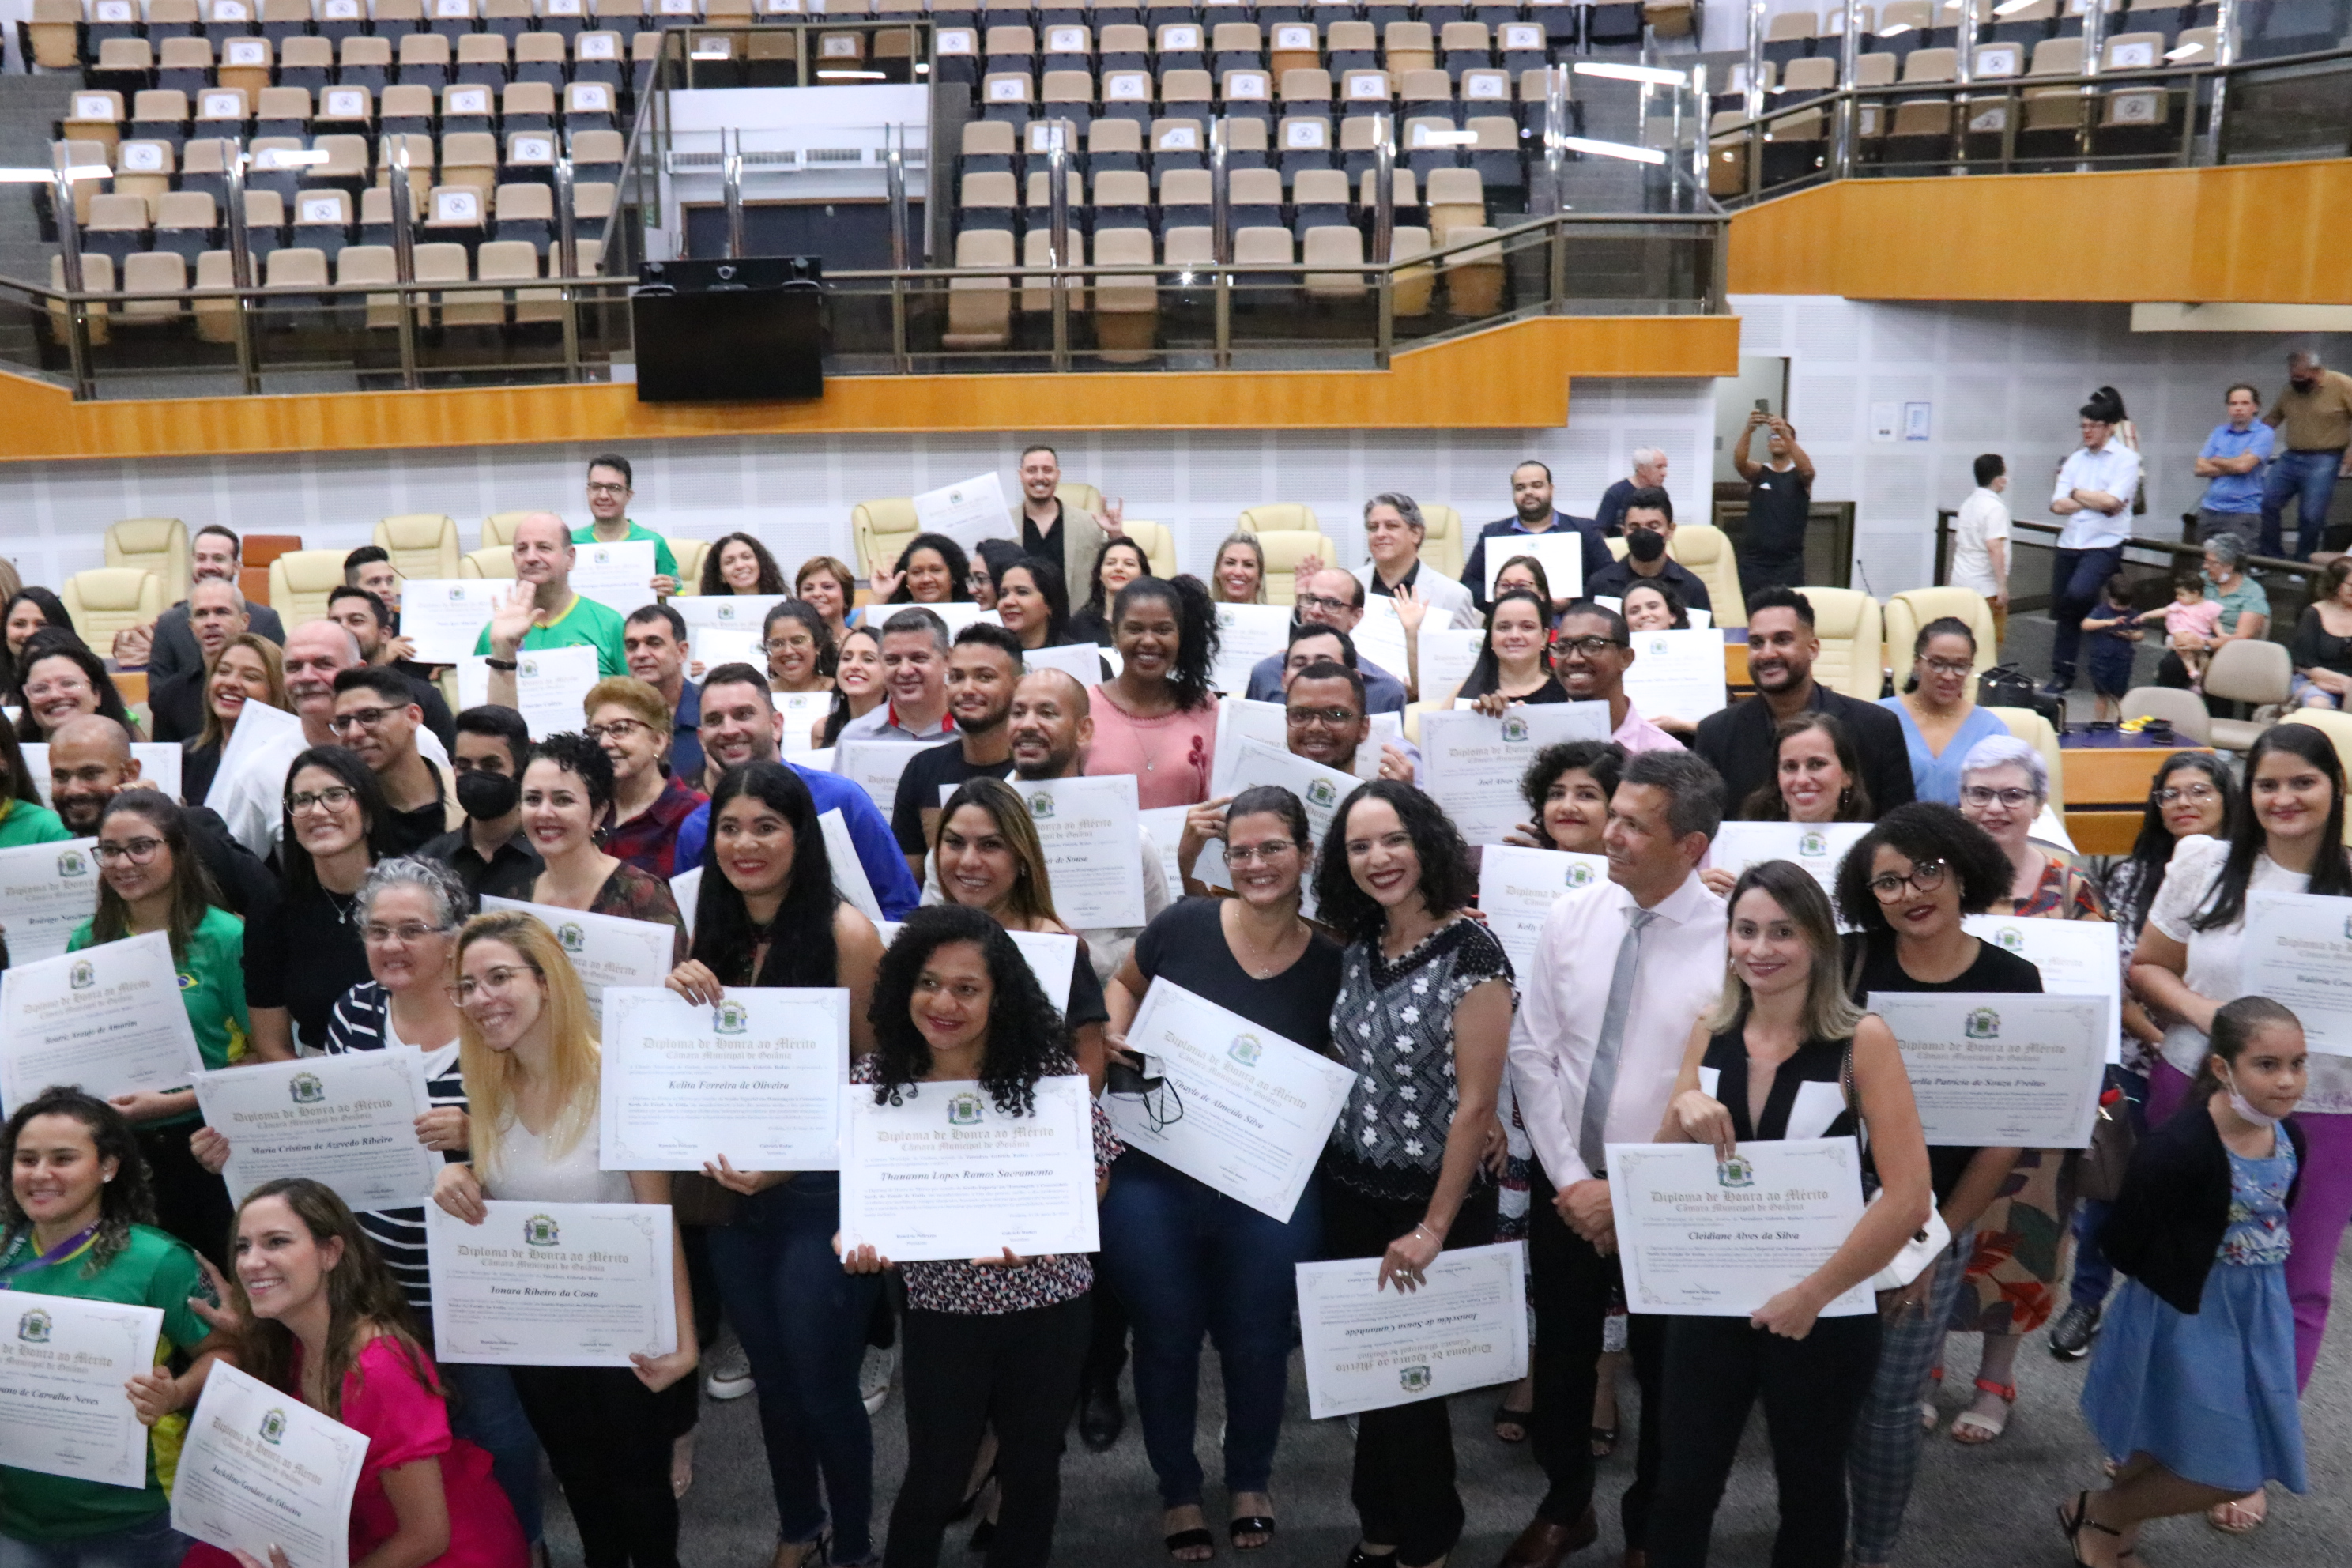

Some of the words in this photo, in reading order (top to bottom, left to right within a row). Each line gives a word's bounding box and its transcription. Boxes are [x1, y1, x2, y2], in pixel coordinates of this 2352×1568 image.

[642, 1038, 695, 1050] Diploma
[699, 1038, 710, 1050] de
[716, 1038, 754, 1050] Honra
[759, 1040, 771, 1050] ao
[775, 1037, 816, 1050] Mérito
[702, 1051, 744, 1061] Municipal
[1164, 1031, 1207, 1061] Diploma
[1208, 1051, 1221, 1066] de
[1223, 1060, 1256, 1084] Honra
[1257, 1080, 1269, 1091] ao
[1272, 1084, 1306, 1110] Mérito
[669, 1080, 695, 1090] Kelita
[699, 1081, 737, 1090] Ferreira
[752, 1080, 789, 1090] Oliveira
[1173, 1079, 1200, 1098] Thayla
[1200, 1091, 1211, 1102] de
[1212, 1099, 1242, 1118] Almeida
[1243, 1112, 1264, 1129] Silva
[233, 1110, 280, 1124] Diploma
[284, 1109, 294, 1118] de
[338, 1103, 349, 1112] ao
[877, 1130, 929, 1143] Diploma
[934, 1130, 947, 1140] de
[952, 1129, 989, 1140] Honra
[995, 1129, 1008, 1138] ao
[1012, 1127, 1054, 1138] Mérito
[278, 1144, 312, 1153] Cristina
[326, 1139, 360, 1149] Azevedo
[362, 1136, 393, 1146] Ribeiro
[938, 1142, 980, 1151] Municipal
[881, 1171, 929, 1181] Thauanna
[933, 1171, 960, 1182] Lopes
[964, 1170, 994, 1179] Ramos
[997, 1169, 1053, 1178] Sacramento
[1650, 1191, 1702, 1204] Diploma
[1706, 1192, 1718, 1202] de
[1723, 1191, 1762, 1202] Honra
[1785, 1189, 1829, 1200] Mérito
[1712, 1204, 1755, 1212] Municipal
[1776, 1231, 1800, 1240] Silva
[457, 1245, 508, 1258] Diploma
[511, 1248, 523, 1258] de
[529, 1248, 566, 1261] Honra
[571, 1252, 583, 1261] ao
[588, 1250, 629, 1264] Mérito
[517, 1261, 557, 1271] Municipal
[524, 1287, 556, 1296] Ribeiro
[574, 1289, 599, 1298] Costa
[1425, 1317, 1435, 1326] de
[57, 1351, 70, 1361] ao
[32, 1389, 71, 1401] Carvalho
[74, 1395, 99, 1405] Neves
[266, 1494, 275, 1502] de
[276, 1498, 302, 1517] Oliveira
